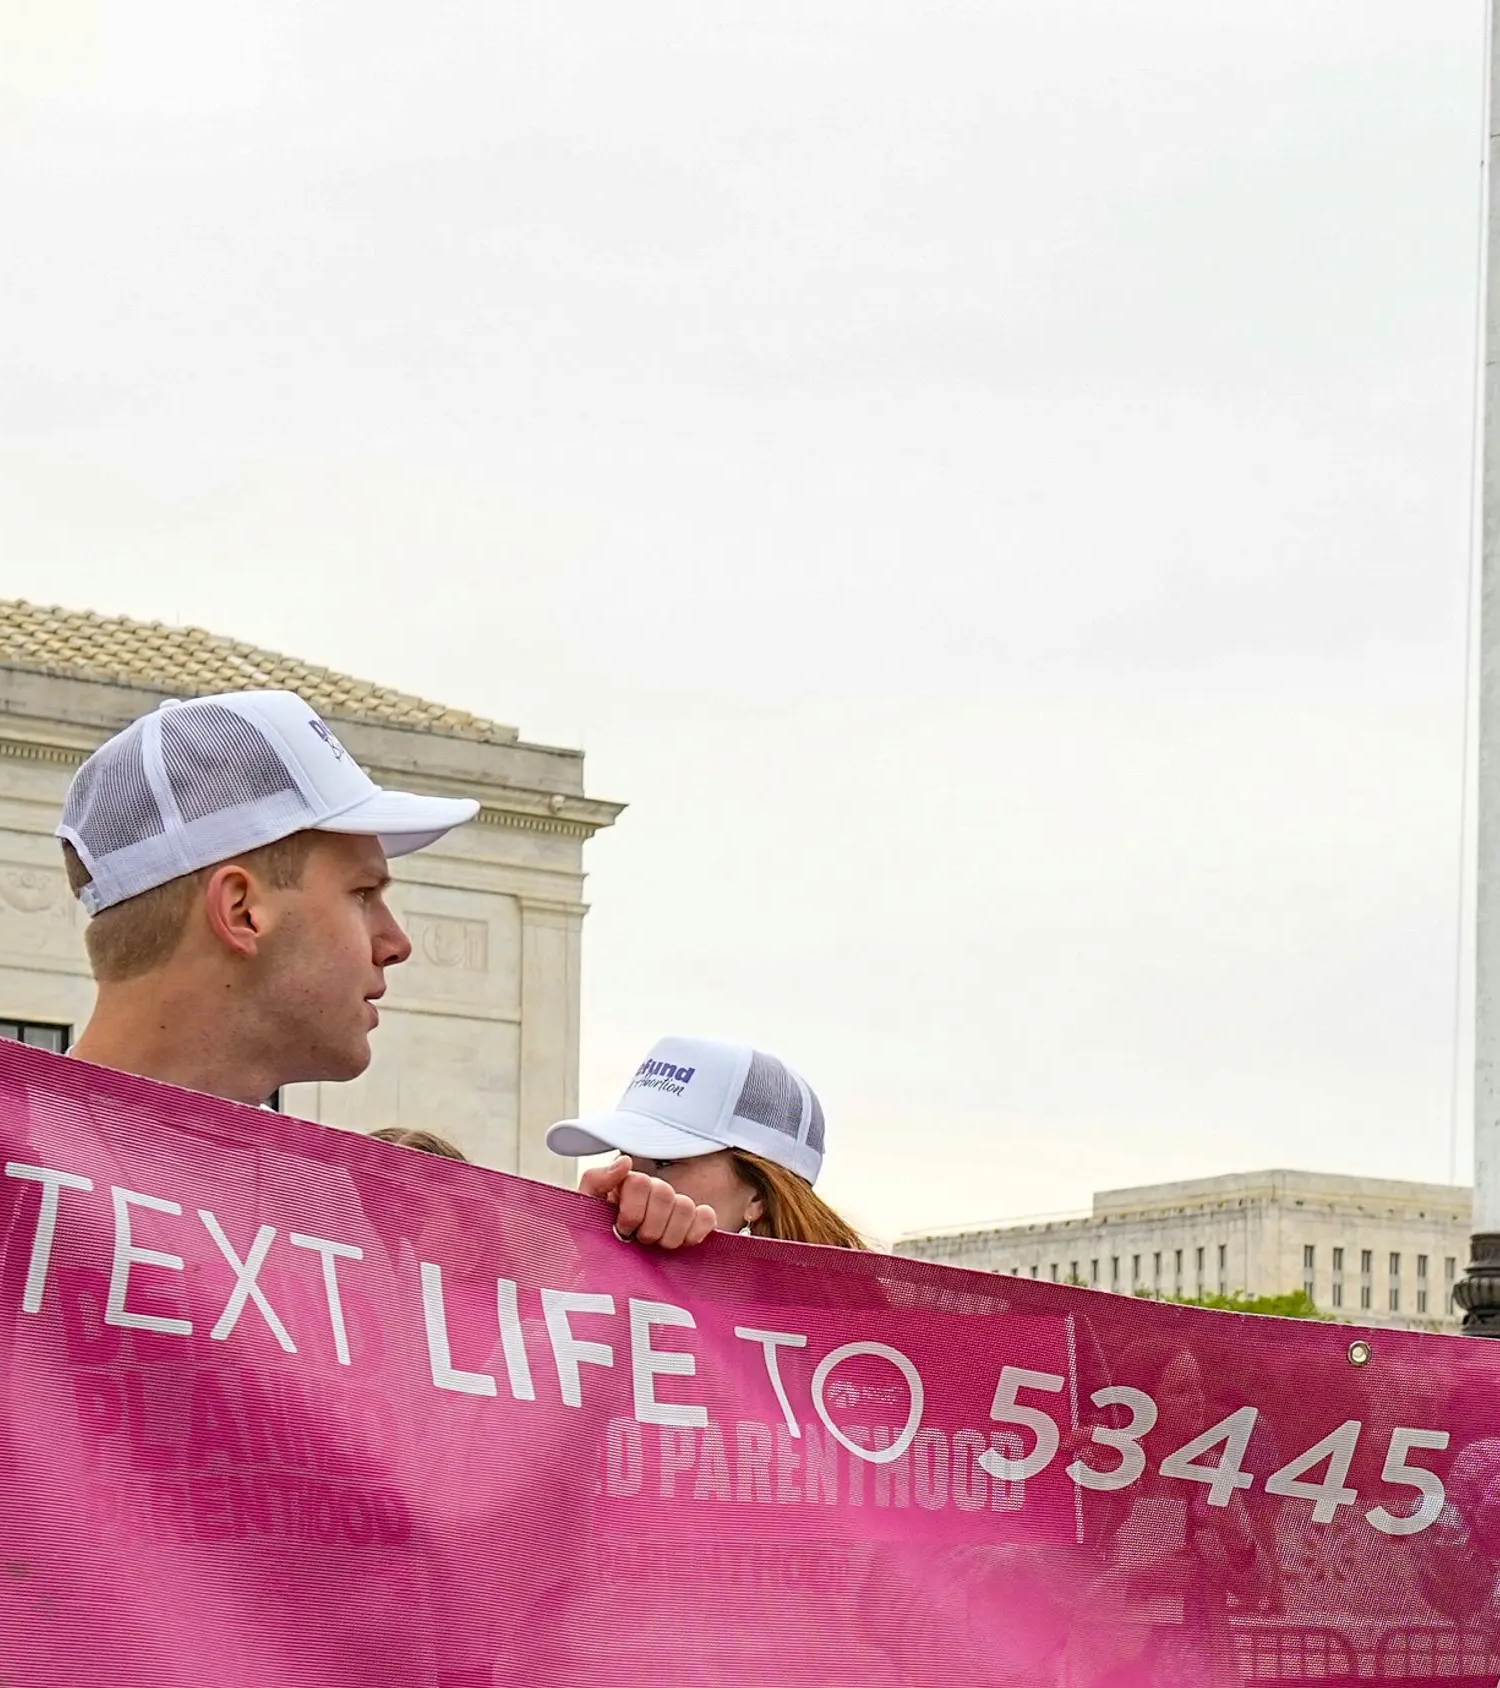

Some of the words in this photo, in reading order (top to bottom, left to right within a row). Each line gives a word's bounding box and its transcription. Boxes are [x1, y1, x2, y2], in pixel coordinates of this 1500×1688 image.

[4, 1161, 364, 1367] TEXT
[419, 1261, 710, 1430] LIFE
[733, 1325, 926, 1465] TO
[978, 1364, 1452, 1539] 53445
